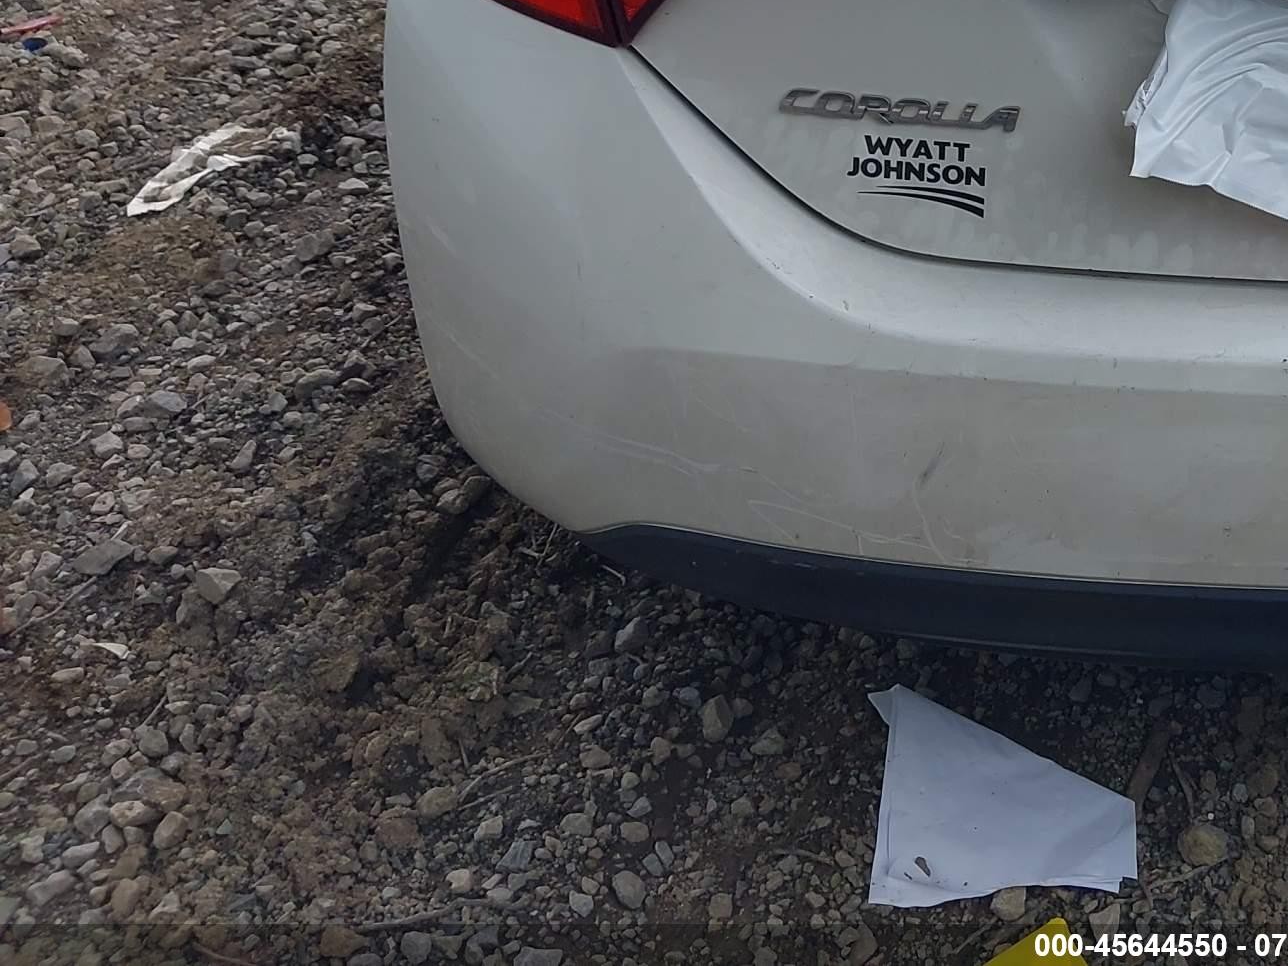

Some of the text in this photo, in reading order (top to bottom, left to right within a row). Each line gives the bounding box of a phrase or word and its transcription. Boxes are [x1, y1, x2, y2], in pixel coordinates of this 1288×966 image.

[779, 87, 1021, 132] COROLLA
[864, 134, 971, 162] WYATT
[847, 157, 986, 186] JOHNSON
